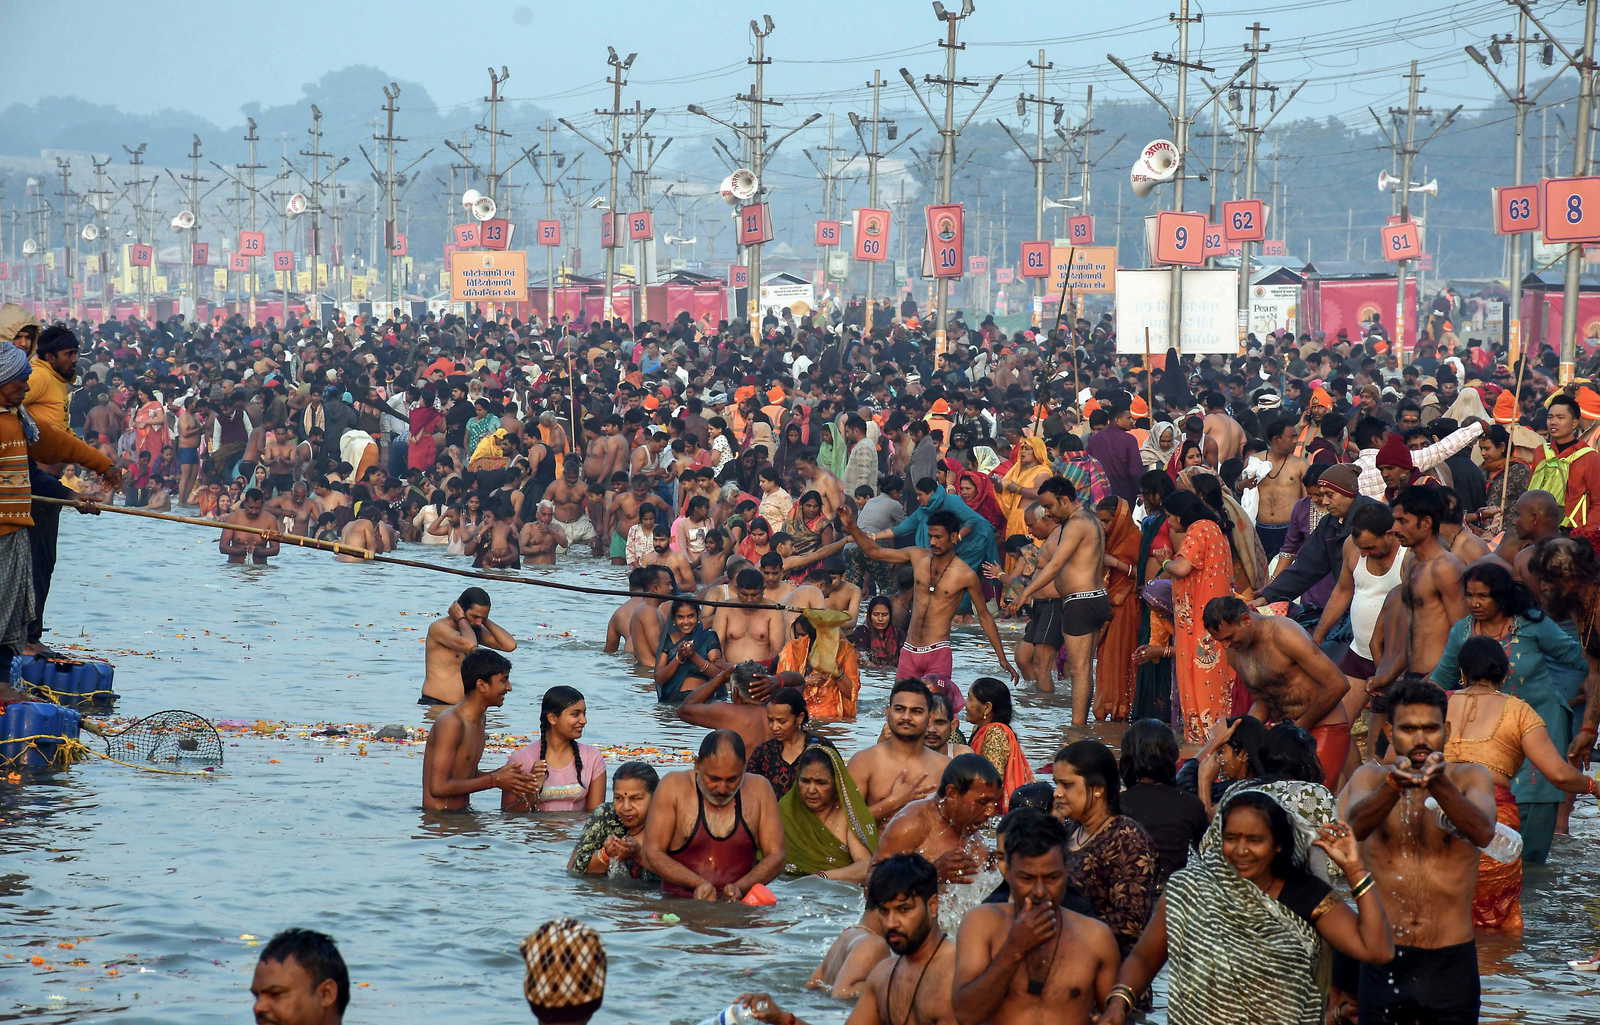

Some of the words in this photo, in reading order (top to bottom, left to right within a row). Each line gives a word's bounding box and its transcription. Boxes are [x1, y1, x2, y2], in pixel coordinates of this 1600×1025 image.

[1509, 198, 1530, 219] 63
[1566, 194, 1583, 224] 8
[634, 219, 646, 231] 58
[746, 215, 758, 232] 11
[1232, 211, 1253, 230] 62
[462, 230, 474, 241] 56
[487, 225, 502, 240] 13
[544, 226, 555, 238] 57
[822, 228, 834, 238] 85
[1074, 224, 1086, 237] 83
[246, 239, 258, 250] 16
[1175, 226, 1188, 250] 9
[1205, 234, 1221, 248] 82
[1392, 233, 1411, 250] 81
[863, 240, 879, 254] 60
[941, 248, 956, 268] 10
[1028, 252, 1043, 267] 61
[736, 272, 746, 282] 86
[1254, 304, 1278, 312] Pears
